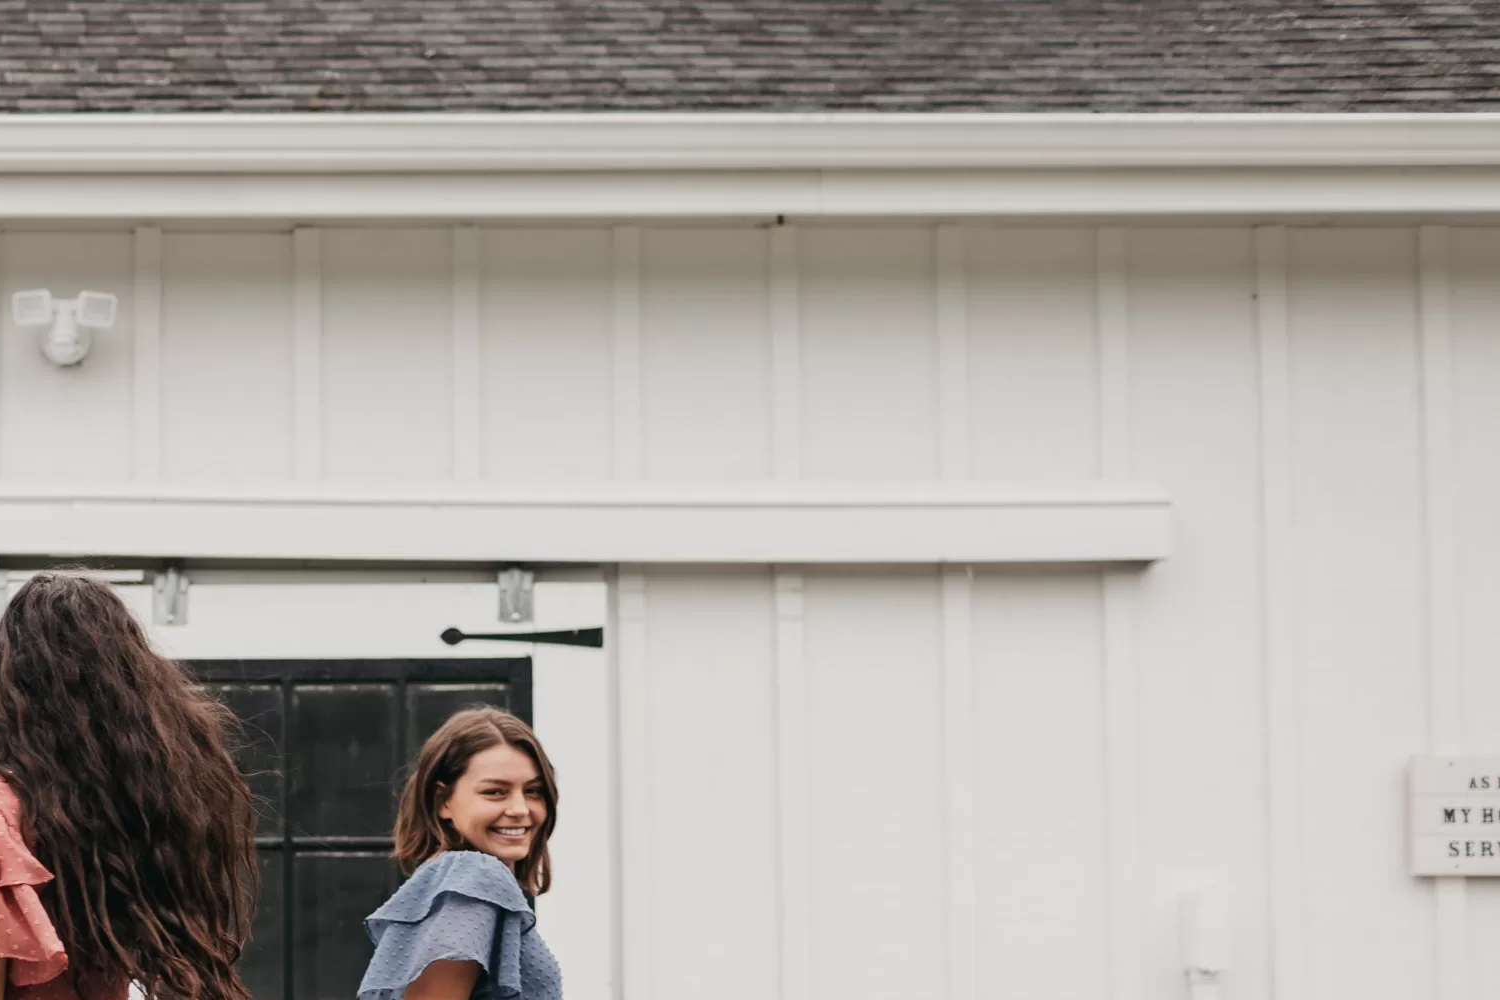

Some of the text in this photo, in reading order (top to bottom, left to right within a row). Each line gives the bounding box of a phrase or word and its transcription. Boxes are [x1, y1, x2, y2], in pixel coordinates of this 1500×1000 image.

[1469, 776, 1490, 788] AS
[1443, 808, 1500, 823] MY H
[1449, 841, 1500, 857] SER
